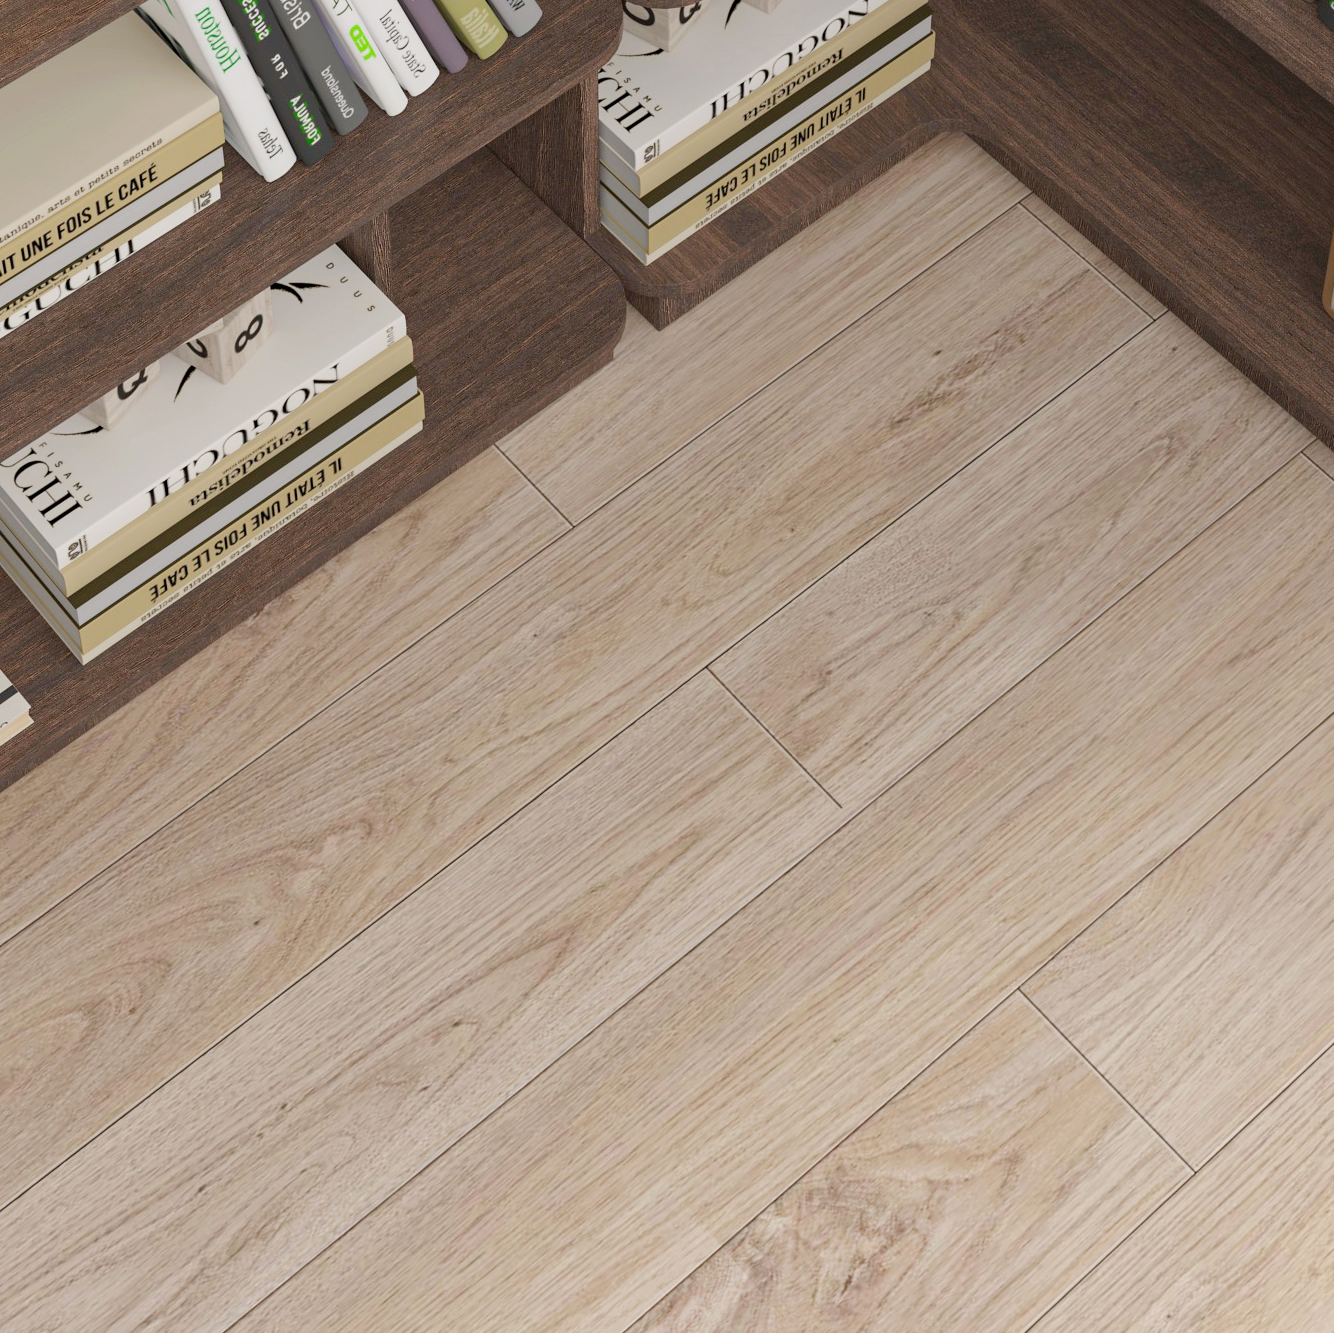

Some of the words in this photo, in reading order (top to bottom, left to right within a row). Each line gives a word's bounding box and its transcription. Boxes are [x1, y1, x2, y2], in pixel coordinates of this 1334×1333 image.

[21, 231, 53, 262] UNE
[56, 207, 92, 240] FOIS
[96, 193, 114, 216] LE
[118, 162, 158, 201] CAFÉ
[146, 363, 340, 507] NOGUCHI
[190, 419, 311, 507] Remodelista
